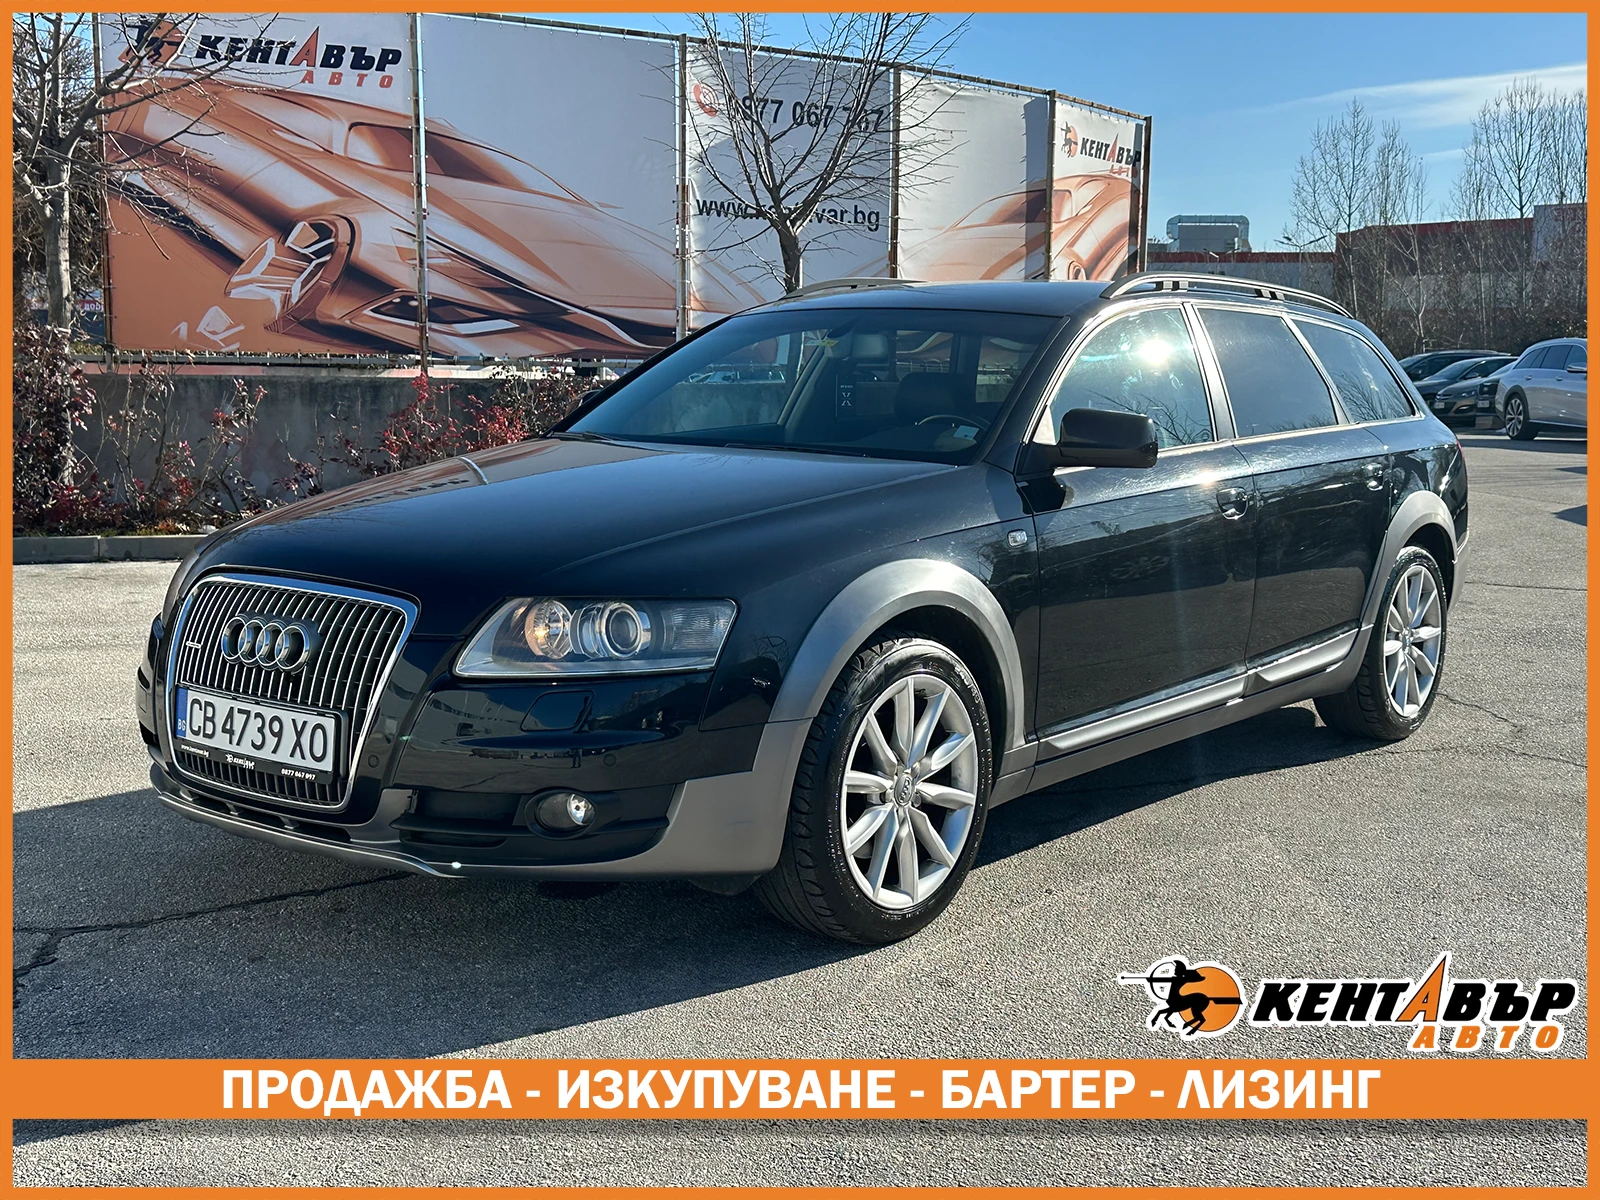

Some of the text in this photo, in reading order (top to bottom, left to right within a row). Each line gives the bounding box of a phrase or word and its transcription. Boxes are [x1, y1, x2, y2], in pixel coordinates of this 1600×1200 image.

[196, 26, 402, 72] КЕНТАВЪР
[300, 70, 394, 89] АВТО
[791, 100, 834, 128] 067
[1080, 132, 1142, 167] КЕНТАВЪР
[177, 718, 187, 732] BG
[221, 706, 284, 755] 4739
